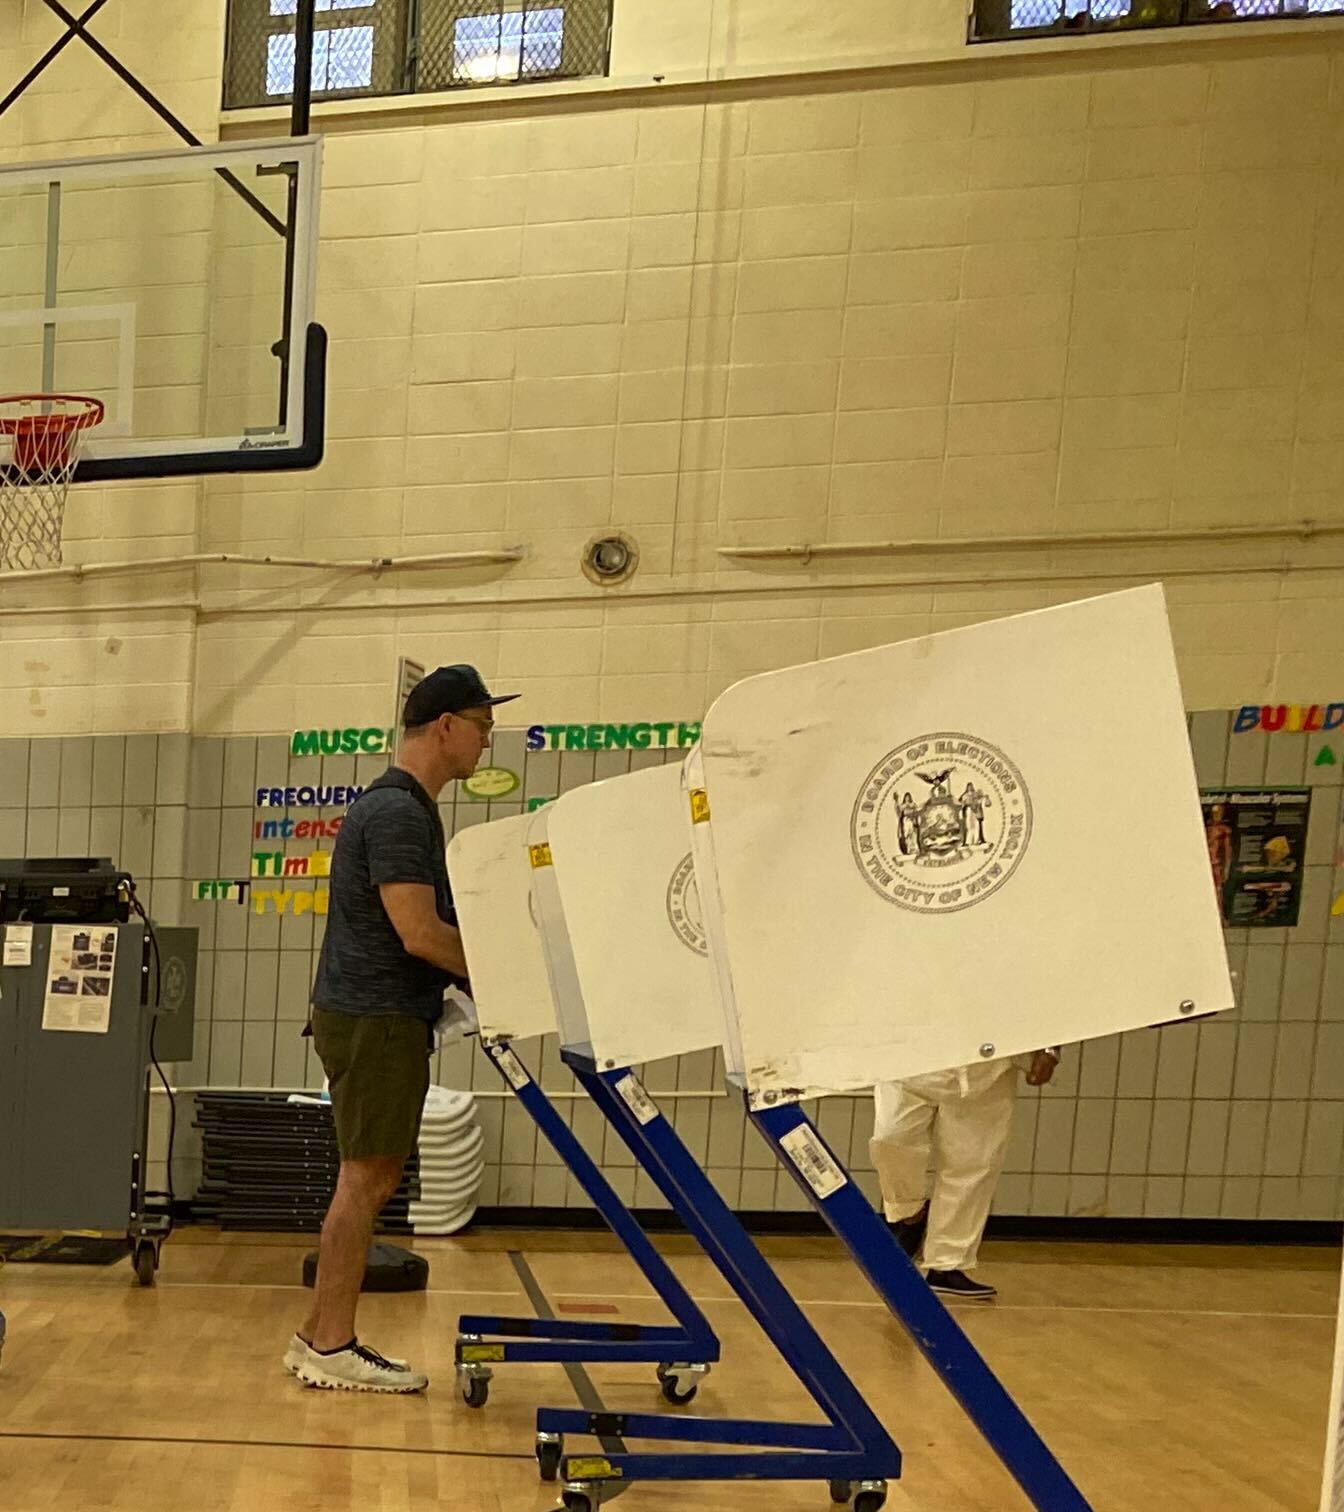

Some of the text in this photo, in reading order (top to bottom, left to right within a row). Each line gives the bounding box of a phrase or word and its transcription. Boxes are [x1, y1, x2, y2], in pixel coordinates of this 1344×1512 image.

[1233, 703, 1344, 733] BUILD
[527, 721, 702, 750] STRENGTH
[251, 890, 329, 915] TYPE
